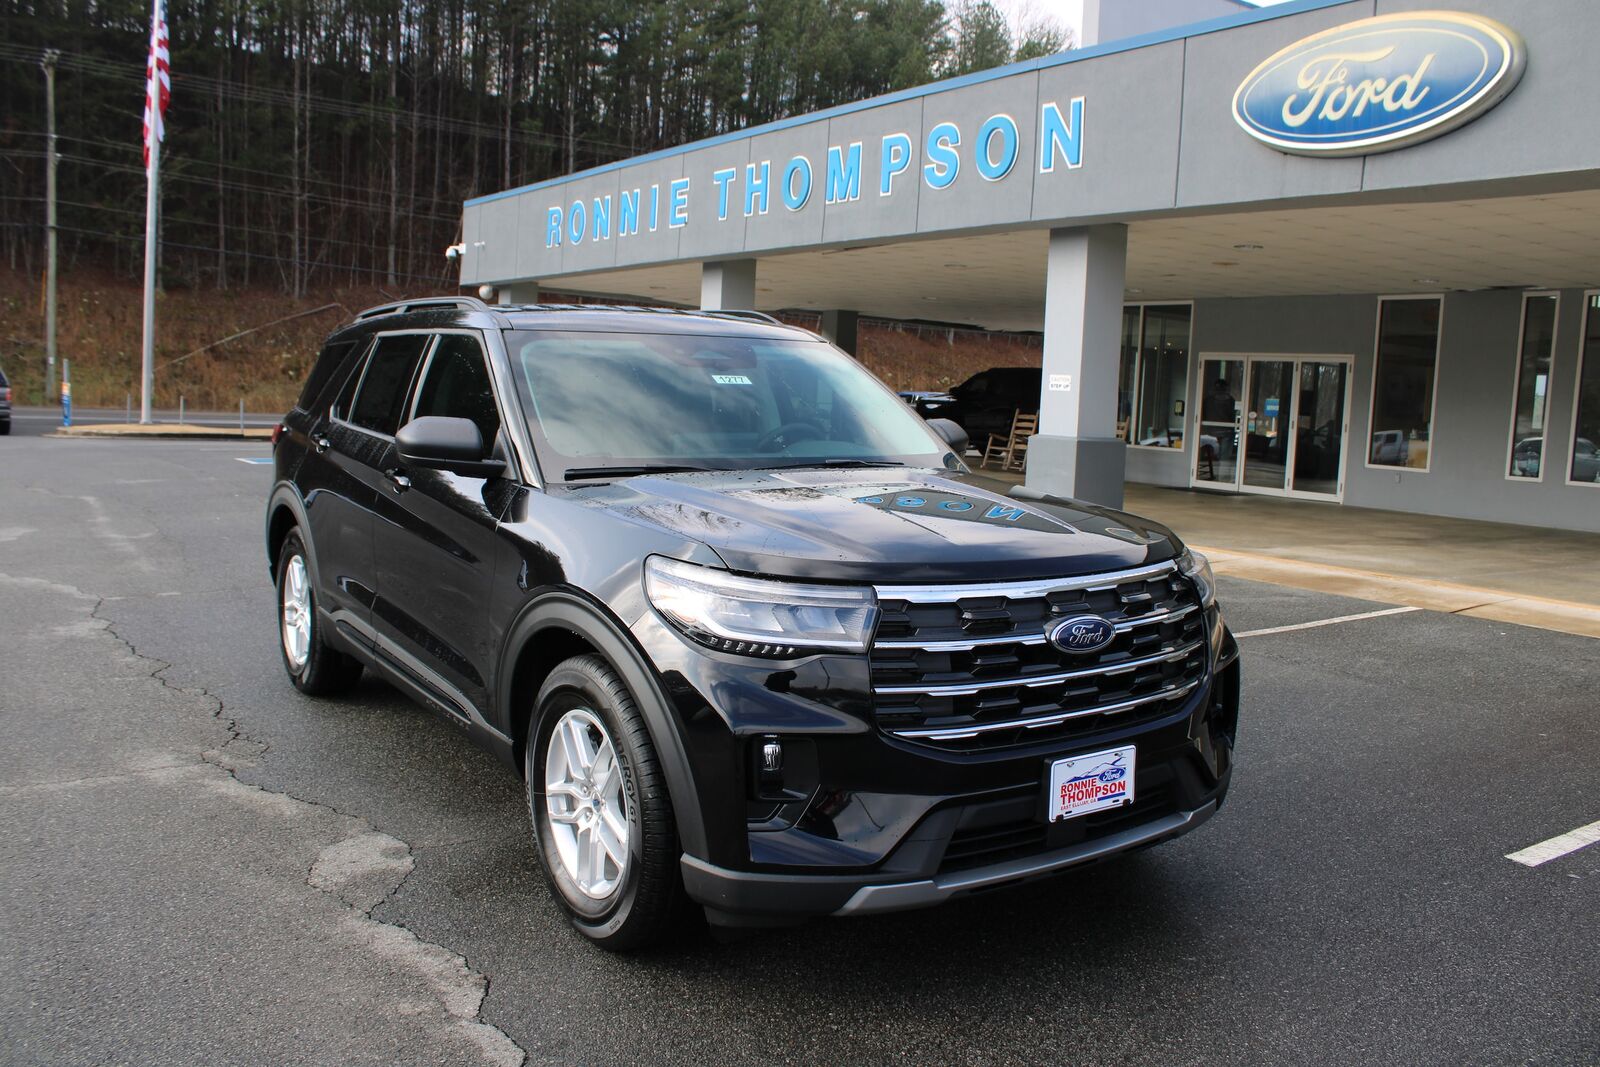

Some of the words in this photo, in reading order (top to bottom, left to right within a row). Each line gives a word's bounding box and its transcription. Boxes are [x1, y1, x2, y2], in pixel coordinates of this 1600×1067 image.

[1281, 46, 1436, 127] Ford
[546, 177, 690, 249] RONNIE
[713, 96, 1085, 220] THOMPSON
[1069, 624, 1104, 646] Ford
[1060, 778, 1097, 795] RONNIE
[1060, 780, 1126, 805] THOMPSON
[629, 805, 637, 827] GT
